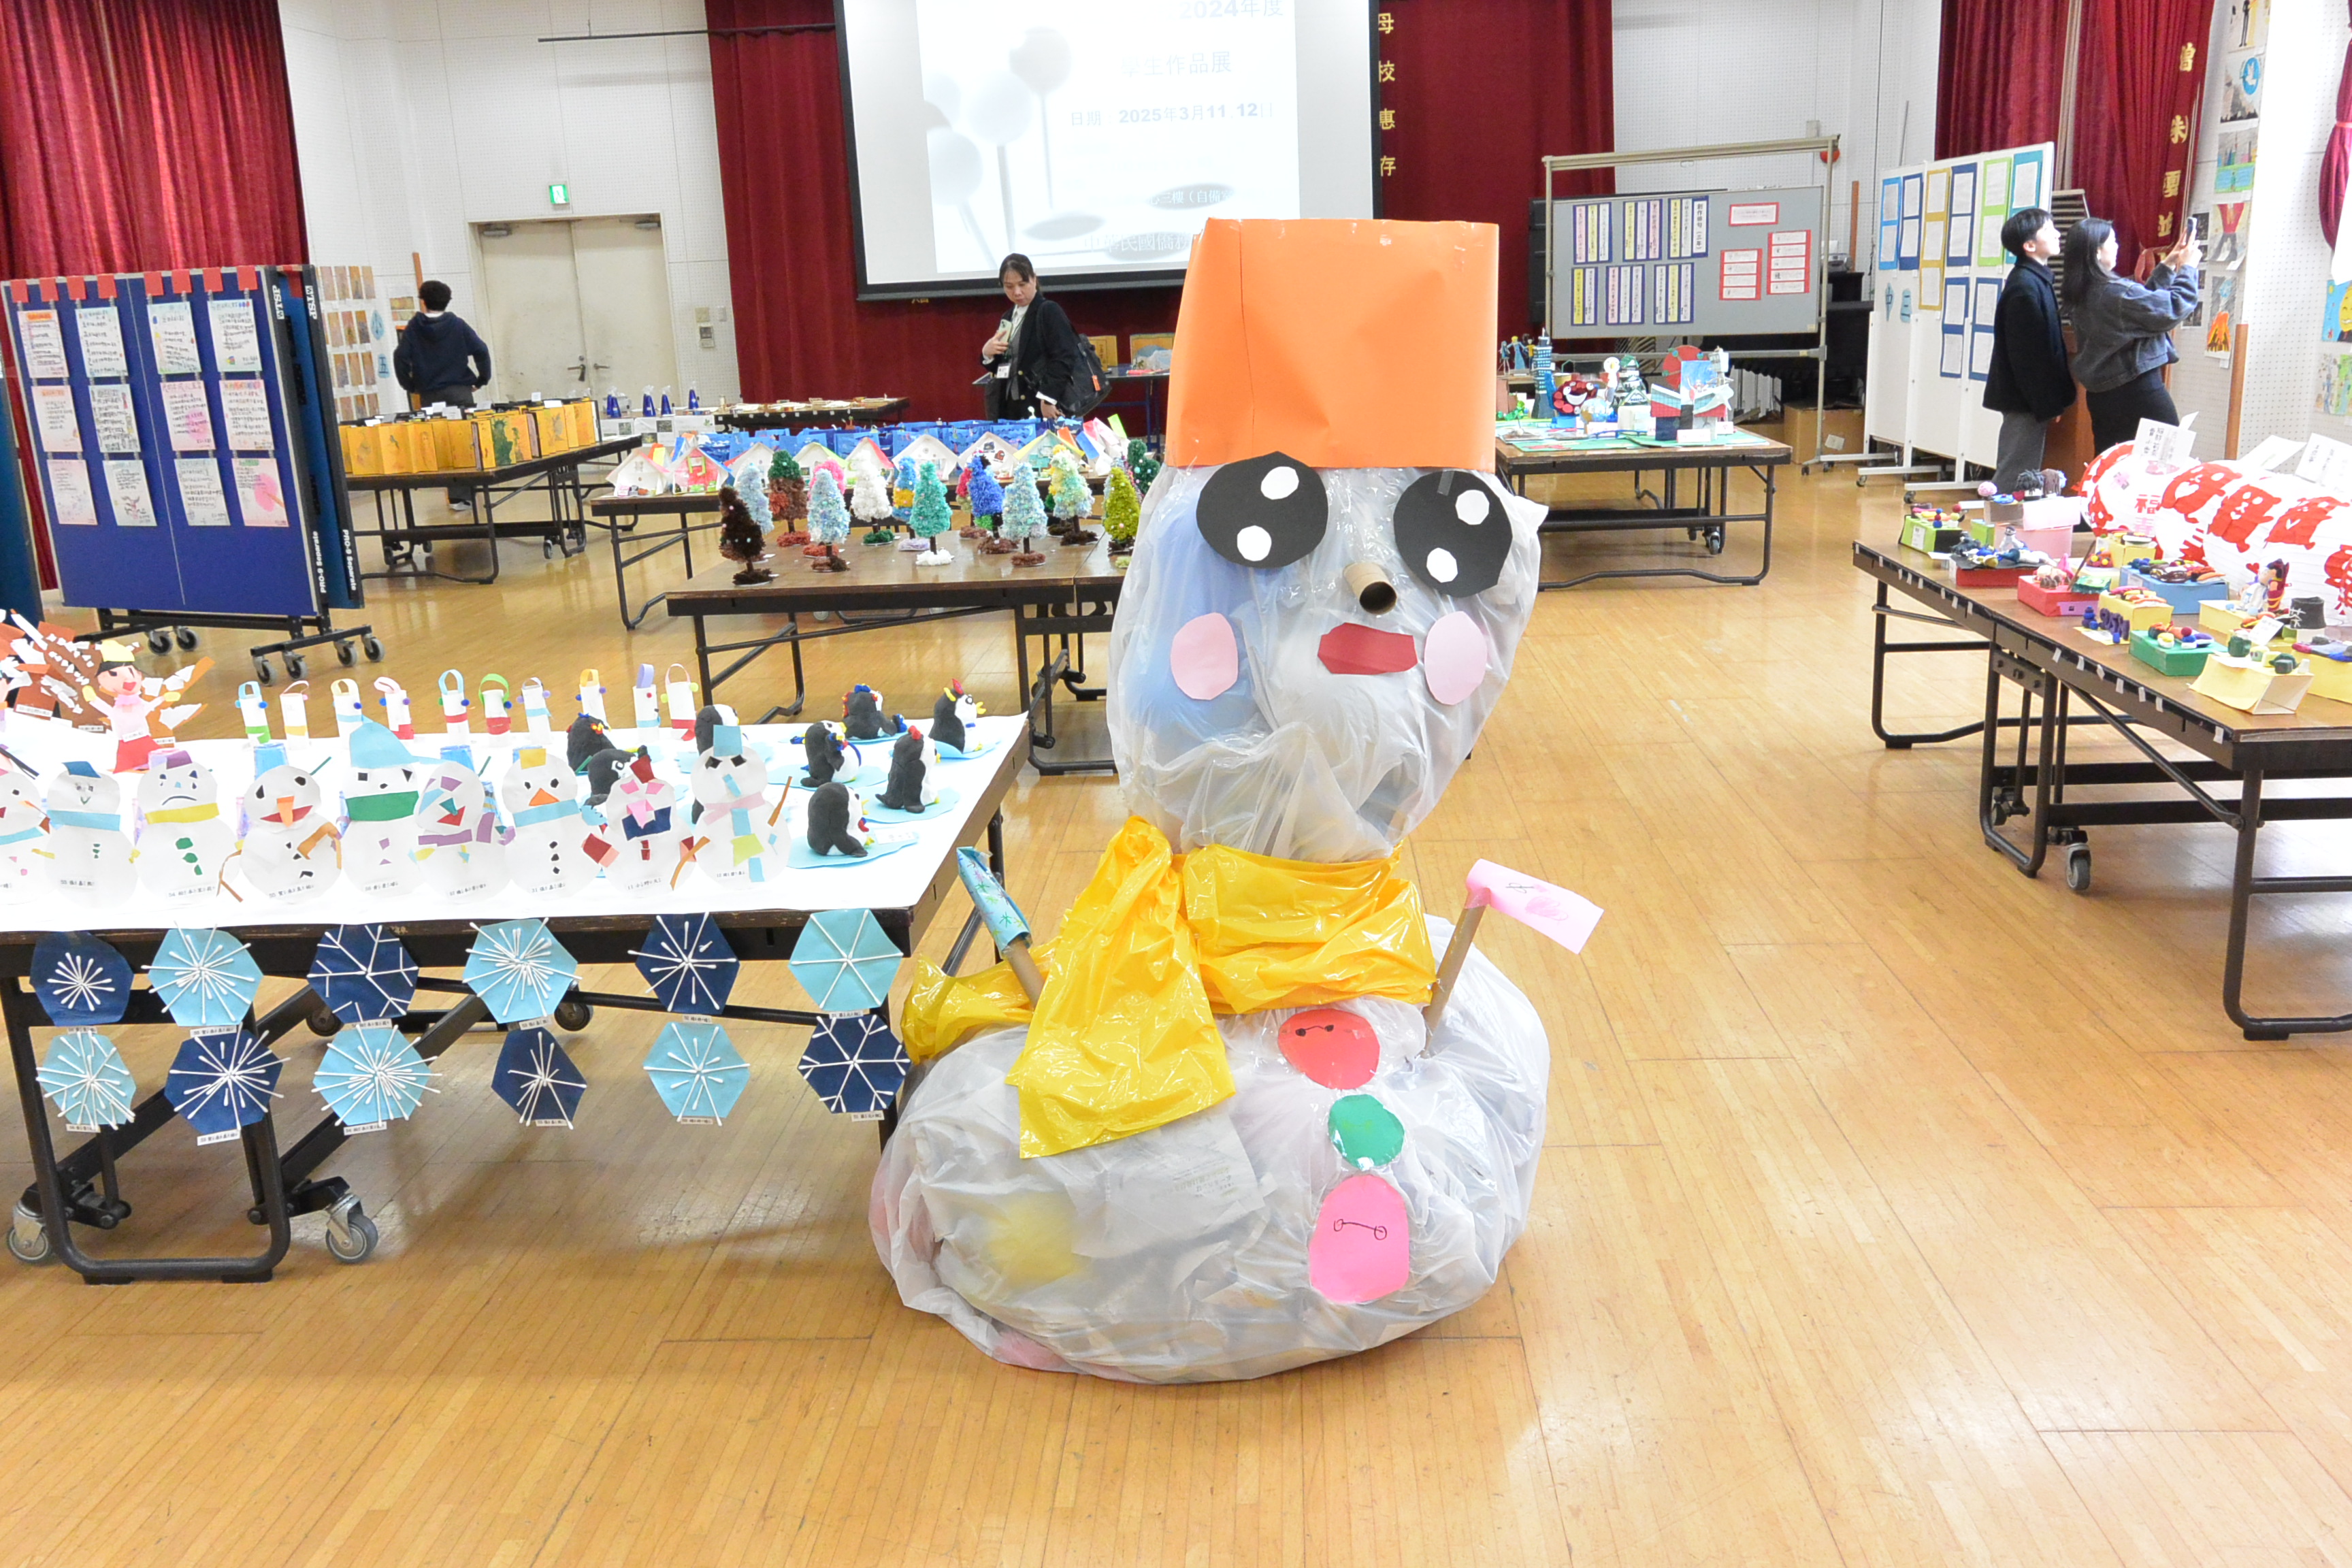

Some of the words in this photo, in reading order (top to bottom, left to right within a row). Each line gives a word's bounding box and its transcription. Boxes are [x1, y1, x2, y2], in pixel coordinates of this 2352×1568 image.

[1121, 50, 1232, 78] 學生作品展
[305, 284, 318, 320] WTSP
